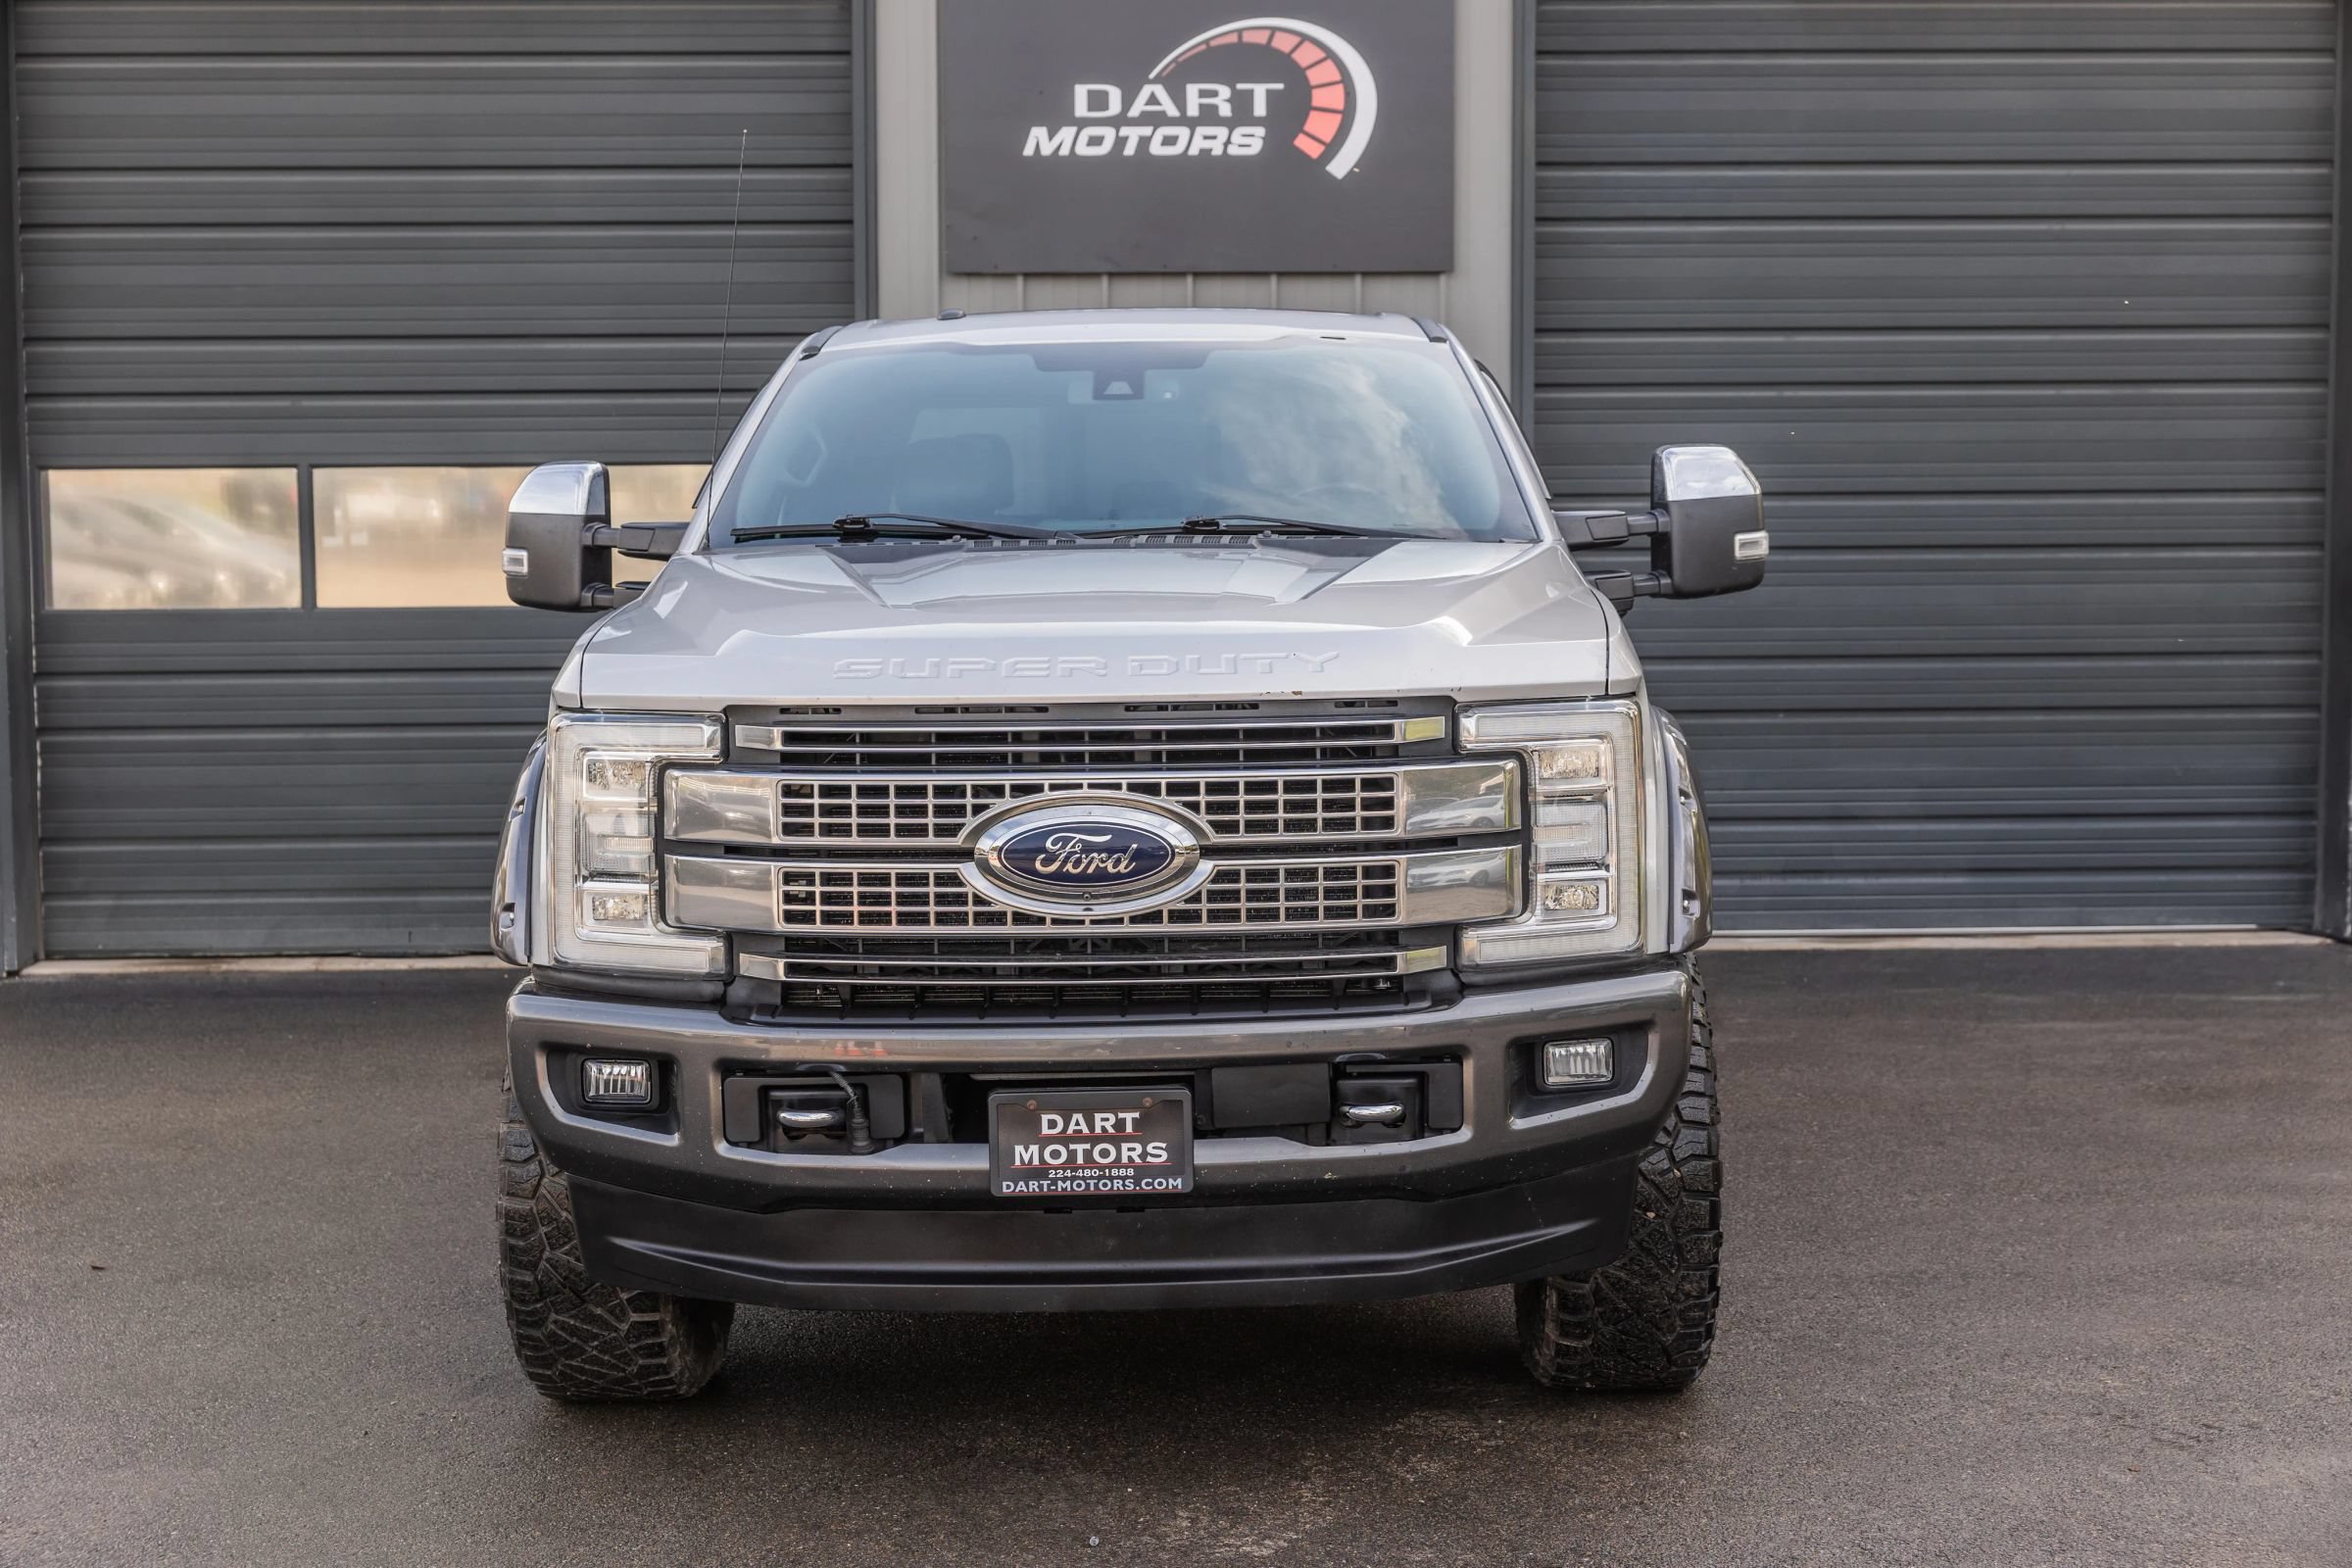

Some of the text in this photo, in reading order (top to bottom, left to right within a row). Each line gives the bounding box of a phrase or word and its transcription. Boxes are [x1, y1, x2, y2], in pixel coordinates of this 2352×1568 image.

[1074, 82, 1284, 118] DART
[1022, 125, 1266, 157] MOTORS
[833, 651, 1340, 680] SUPER DUTY
[1035, 833, 1138, 874] Ford
[1040, 1111, 1141, 1135] DART
[1014, 1142, 1168, 1165] MOTORS
[1002, 1178, 1182, 1193] DART-MOTORS.COM
[1048, 1168, 1135, 1178] 224-480-1888
